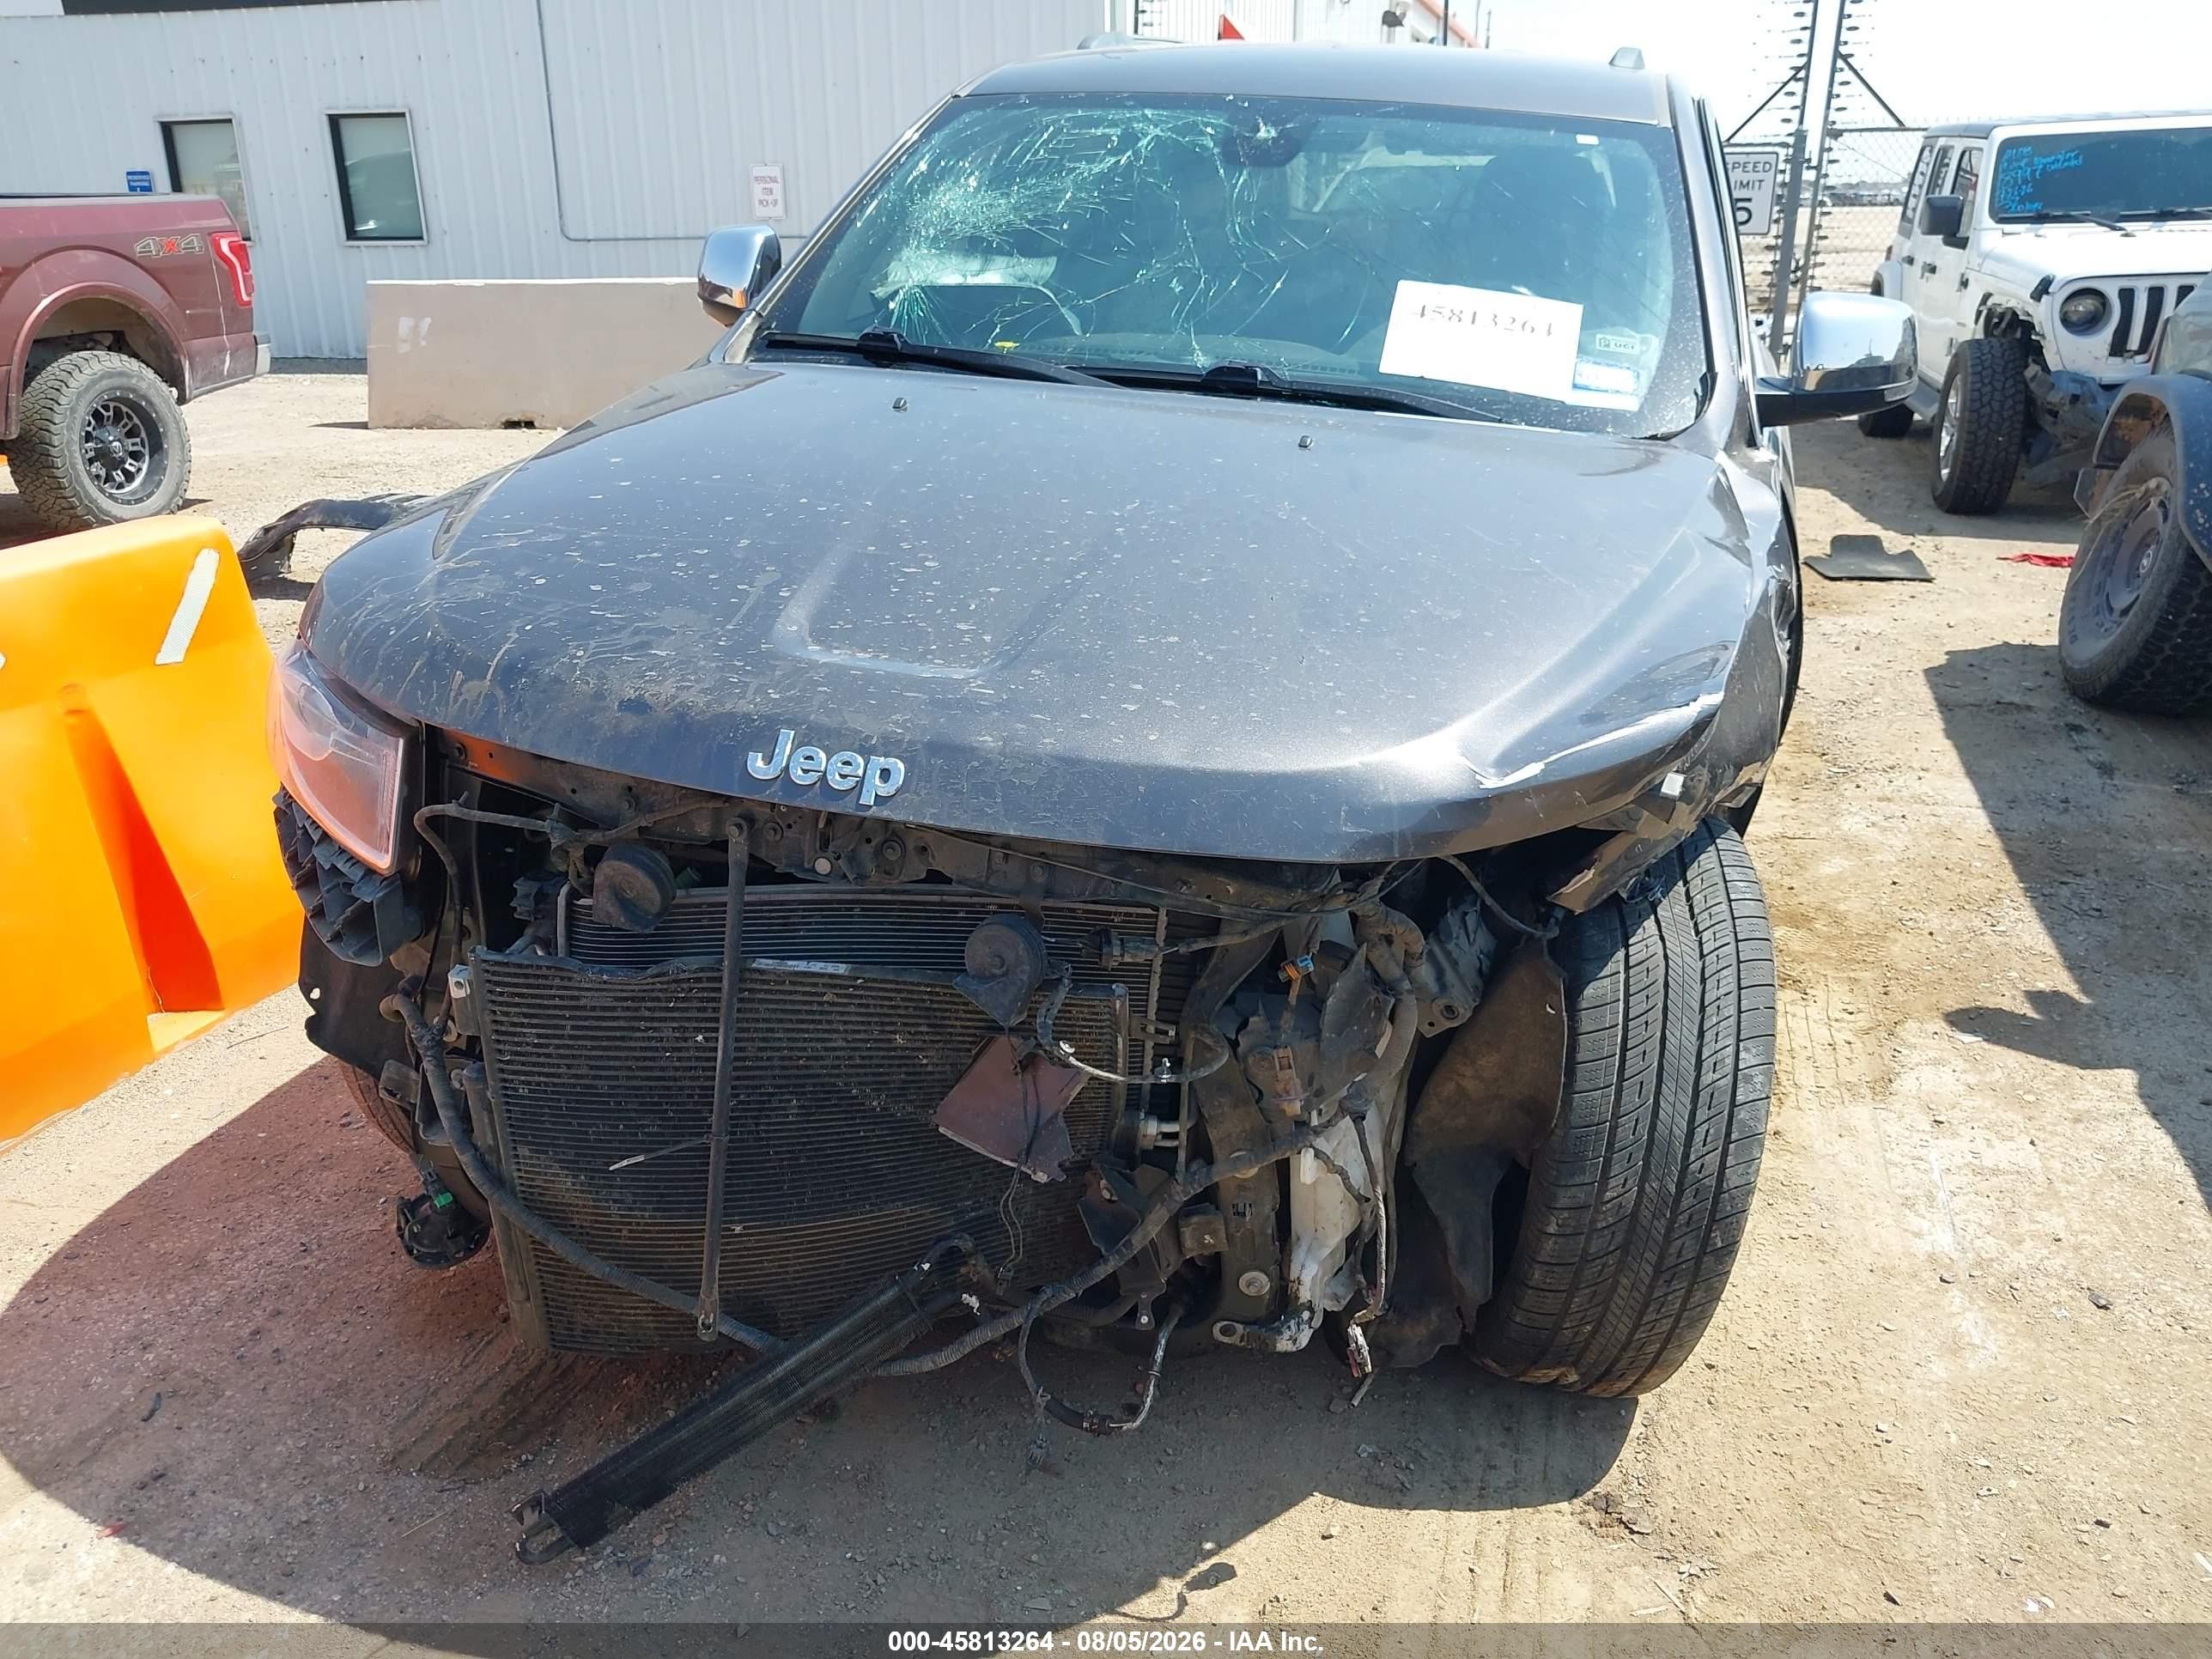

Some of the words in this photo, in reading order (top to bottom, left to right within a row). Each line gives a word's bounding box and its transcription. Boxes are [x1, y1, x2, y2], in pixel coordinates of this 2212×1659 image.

[1726, 161, 1772, 173] PEED
[1733, 179, 1765, 191] IMIT
[747, 729, 905, 806] Jeep
